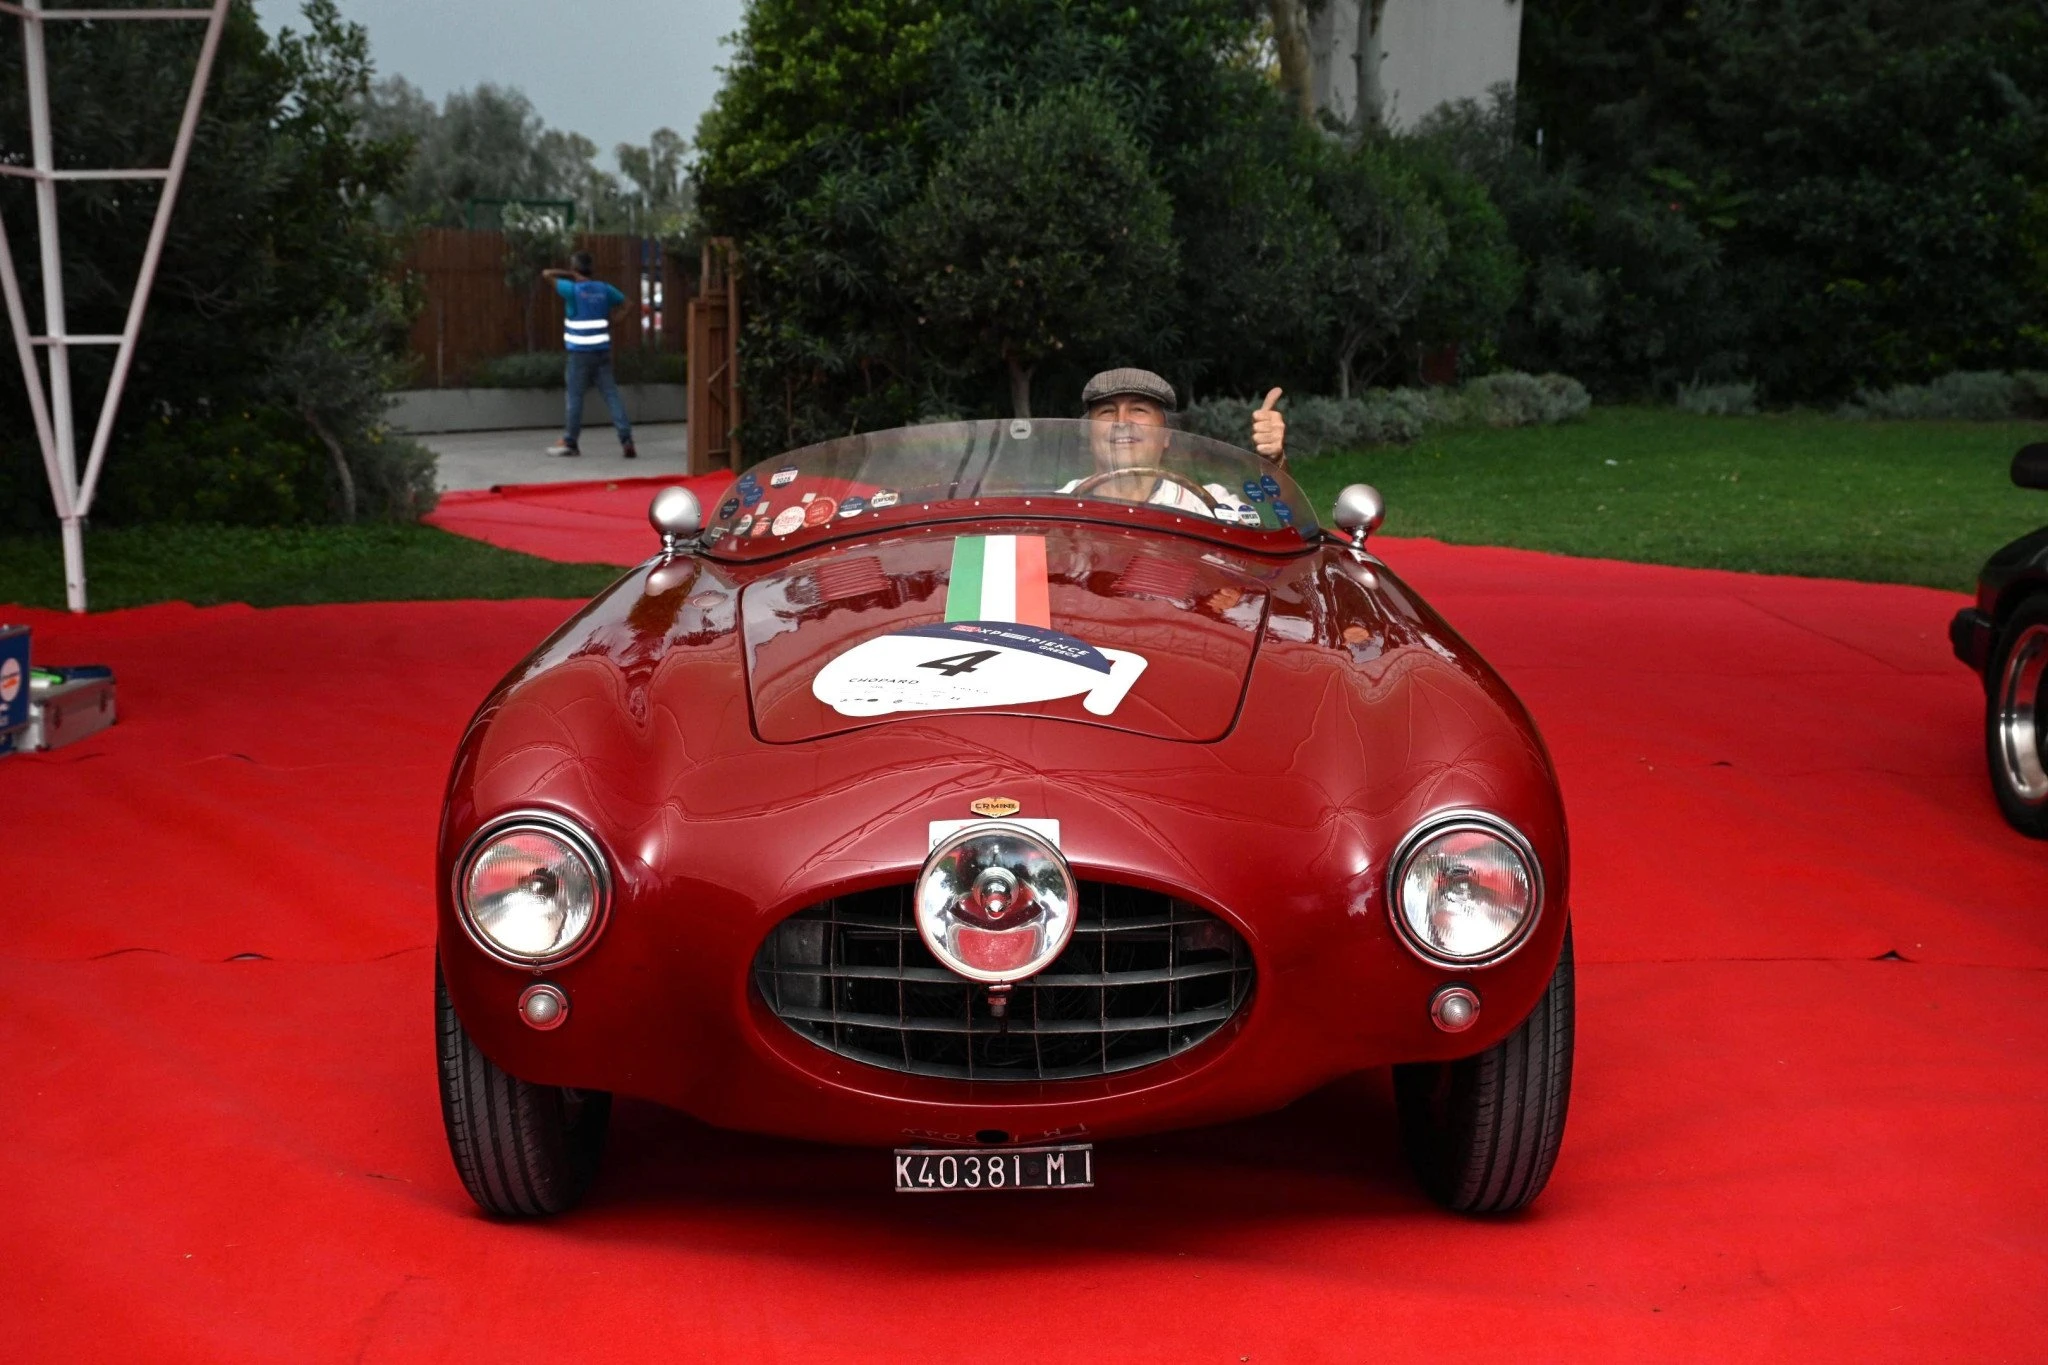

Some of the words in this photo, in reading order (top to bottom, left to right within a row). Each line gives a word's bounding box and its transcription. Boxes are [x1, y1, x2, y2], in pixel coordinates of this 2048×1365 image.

[916, 650, 1002, 677] 4
[848, 677, 920, 686] CHOPARD
[896, 1154, 1021, 1188] K40381
